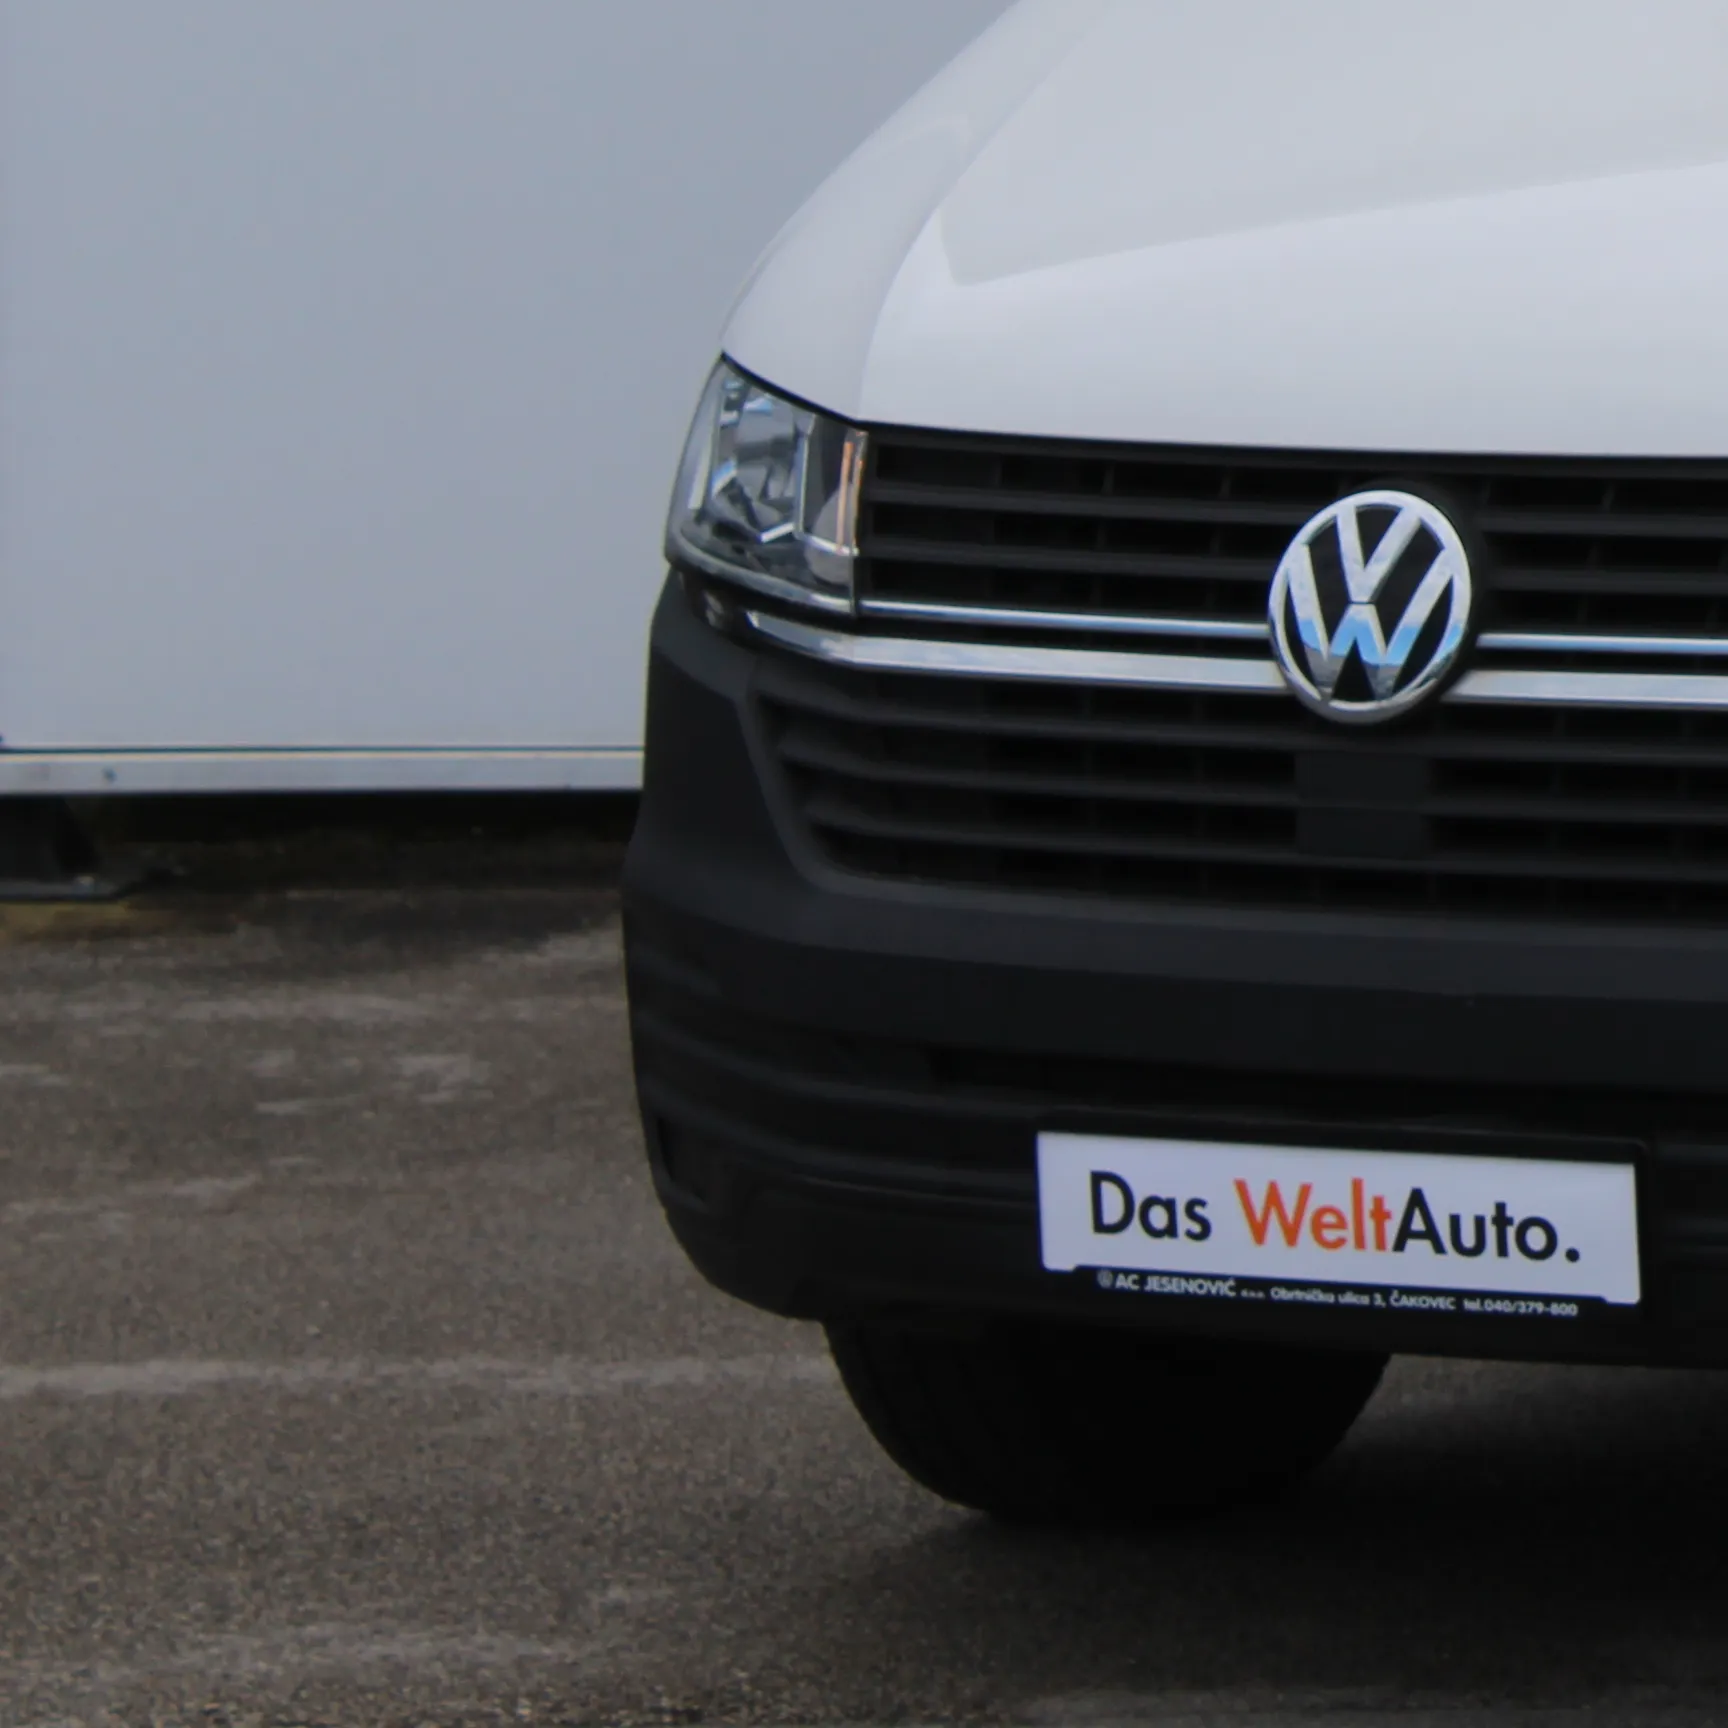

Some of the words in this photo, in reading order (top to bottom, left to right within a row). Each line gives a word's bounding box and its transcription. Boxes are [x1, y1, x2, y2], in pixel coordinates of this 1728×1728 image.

[1089, 1170, 1211, 1242] Das
[1234, 1177, 1580, 1264] WeltAuto.
[1115, 1273, 1139, 1290] AC
[1144, 1274, 1237, 1297] JESENOVIĆ
[1338, 1291, 1370, 1305] ulica
[1389, 1288, 1457, 1310] ČAKOVEC
